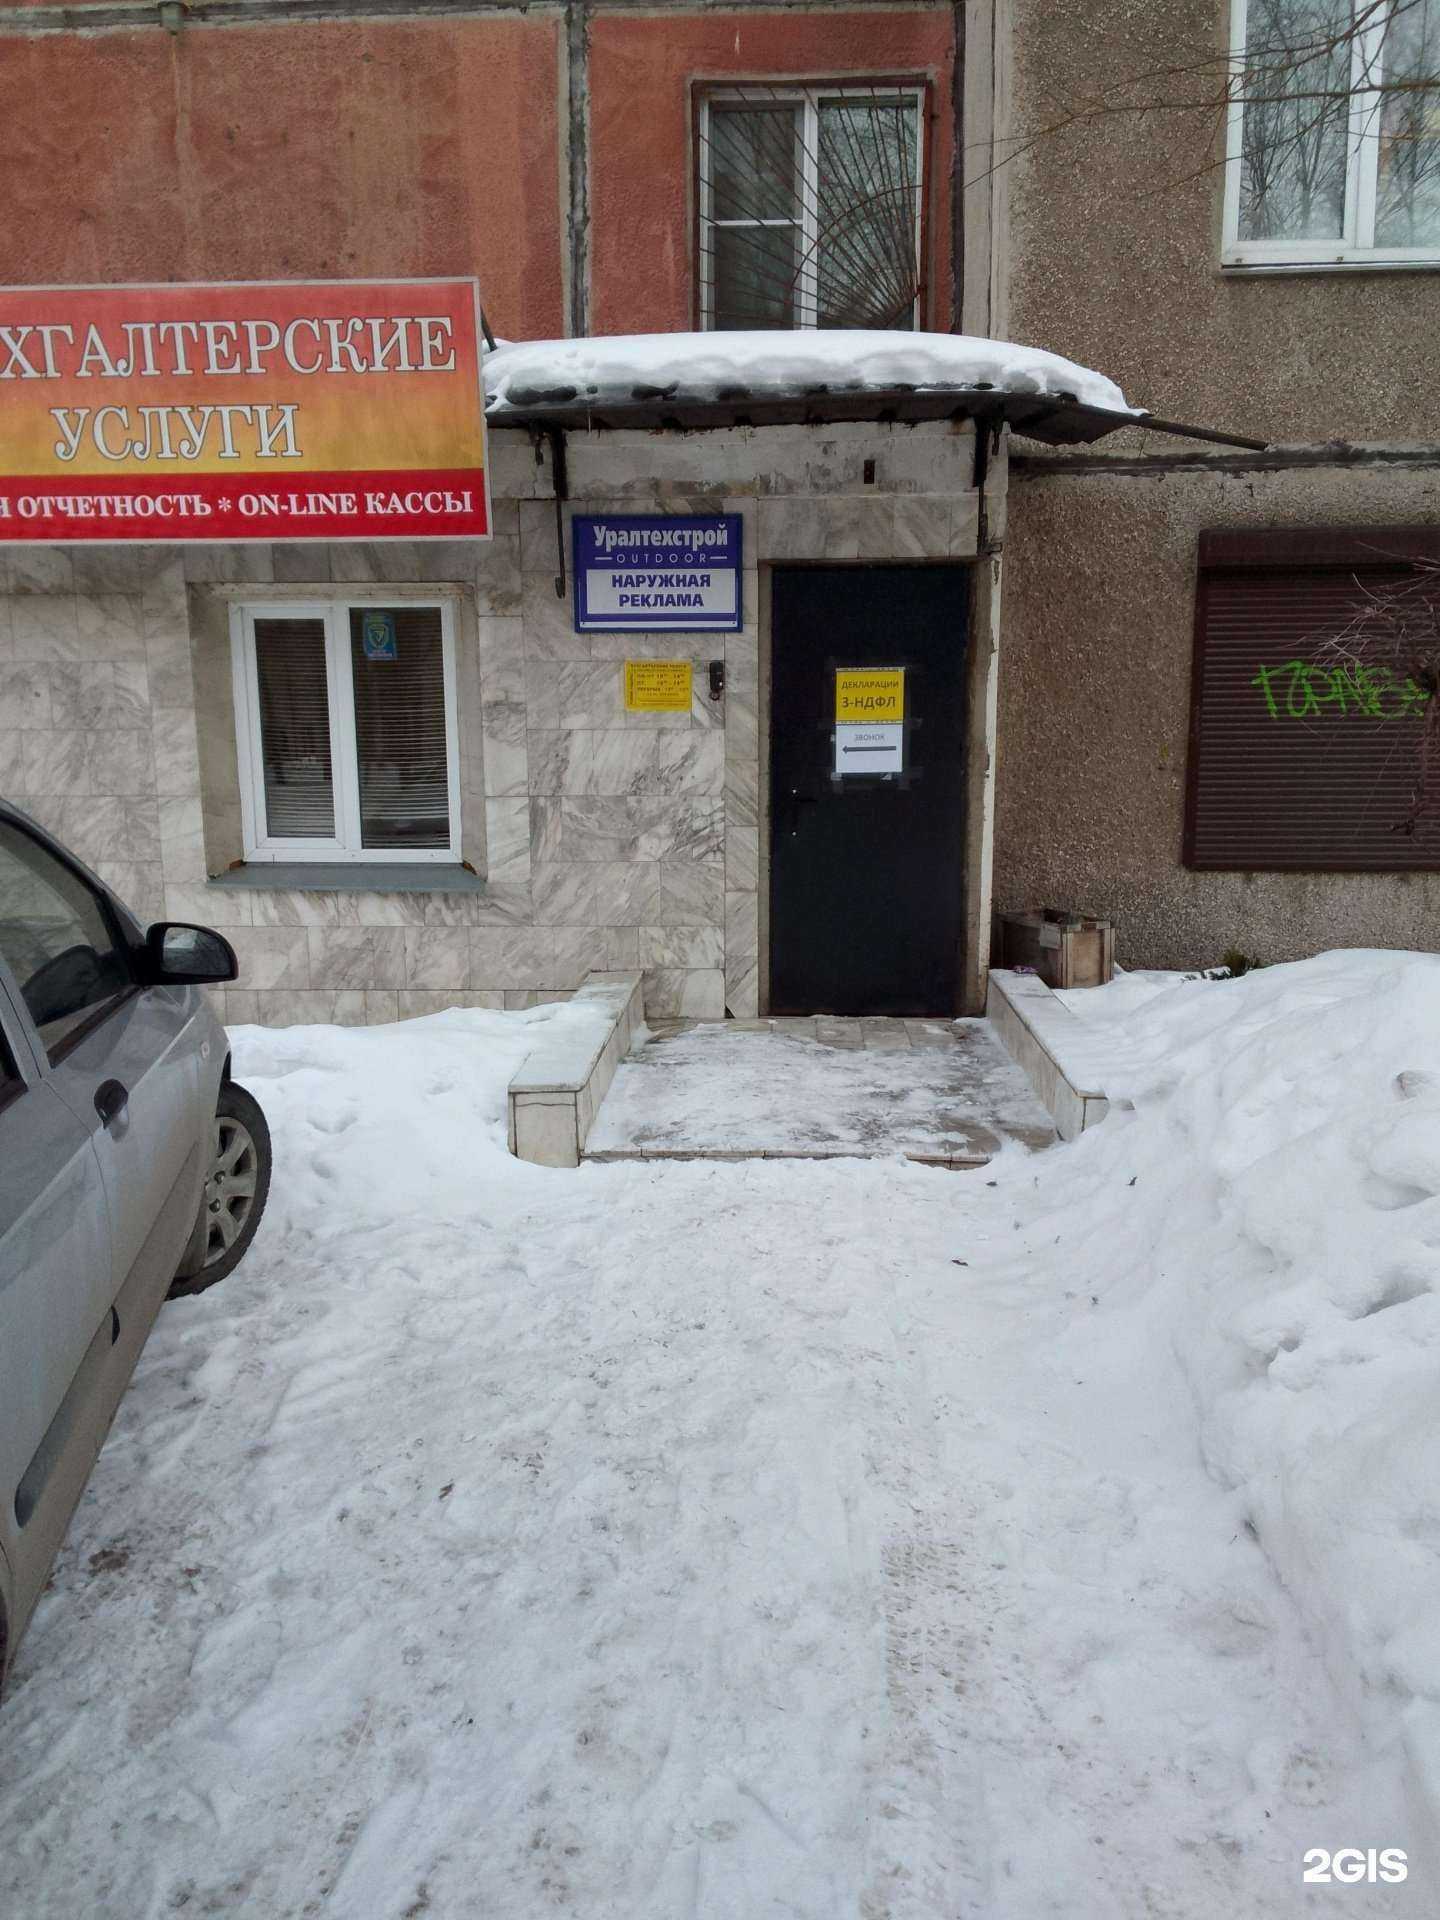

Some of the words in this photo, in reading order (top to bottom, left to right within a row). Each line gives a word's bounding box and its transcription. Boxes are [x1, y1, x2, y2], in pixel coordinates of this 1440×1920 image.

[50, 403, 304, 462] УСЛУГИ
[17, 493, 212, 519] ОТЧЕТНОСТЬ
[238, 492, 358, 517] ON-LINE
[364, 490, 474, 515] КАССЫ
[593, 523, 728, 552] Уралтехстрой
[616, 553, 707, 564] OUTDOOR
[611, 573, 711, 589] НАРУЖНАЯ
[618, 593, 705, 608] РЕКЛАМА
[841, 696, 897, 710] 3-НДФЛ
